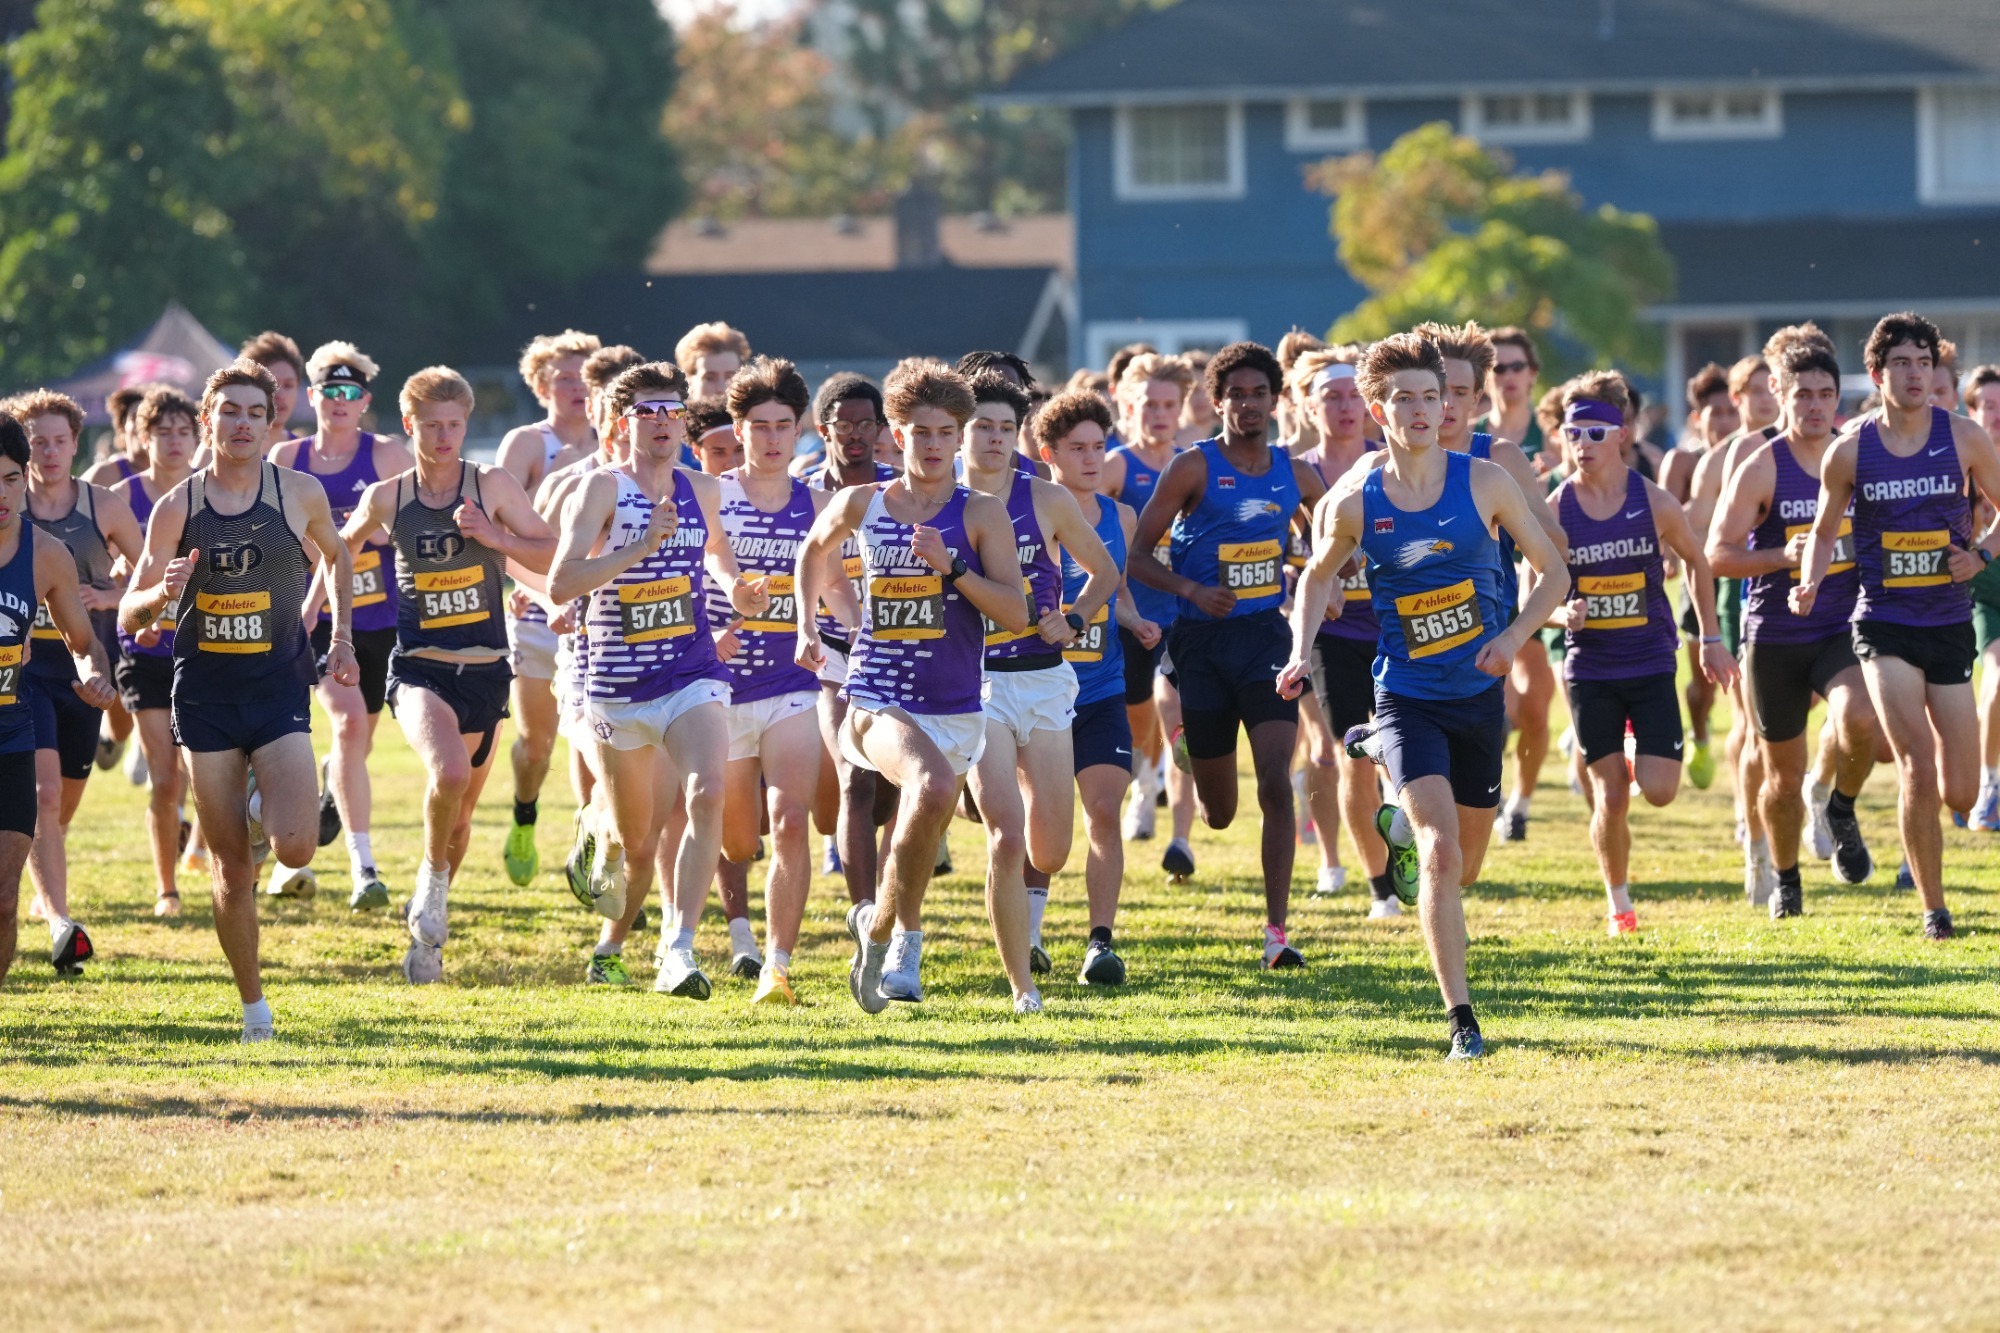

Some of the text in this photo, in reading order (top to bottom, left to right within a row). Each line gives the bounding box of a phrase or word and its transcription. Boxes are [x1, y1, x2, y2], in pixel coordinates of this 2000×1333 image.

[1863, 475, 1956, 501] CARROLL
[728, 535, 803, 559] PORTLAN
[1233, 547, 1273, 558] Athletic
[1567, 537, 1654, 565] CARROLL
[1894, 537, 1938, 547] Athletic
[1228, 560, 1275, 587] 5656
[1890, 551, 1943, 575] 5387
[427, 576, 472, 588] Athletic
[633, 585, 680, 599] Athletic
[767, 581, 791, 590] hletic
[881, 582, 928, 594] Athletic
[1590, 580, 1634, 591] Athletic
[208, 599, 256, 610] Athletic
[424, 588, 480, 616] 5493
[878, 600, 934, 626] 5724
[1412, 591, 1462, 611] Athletic
[1586, 593, 1639, 617] 5392
[631, 600, 685, 629] 5731
[1411, 604, 1473, 643] 5655
[205, 615, 263, 640] 5488
